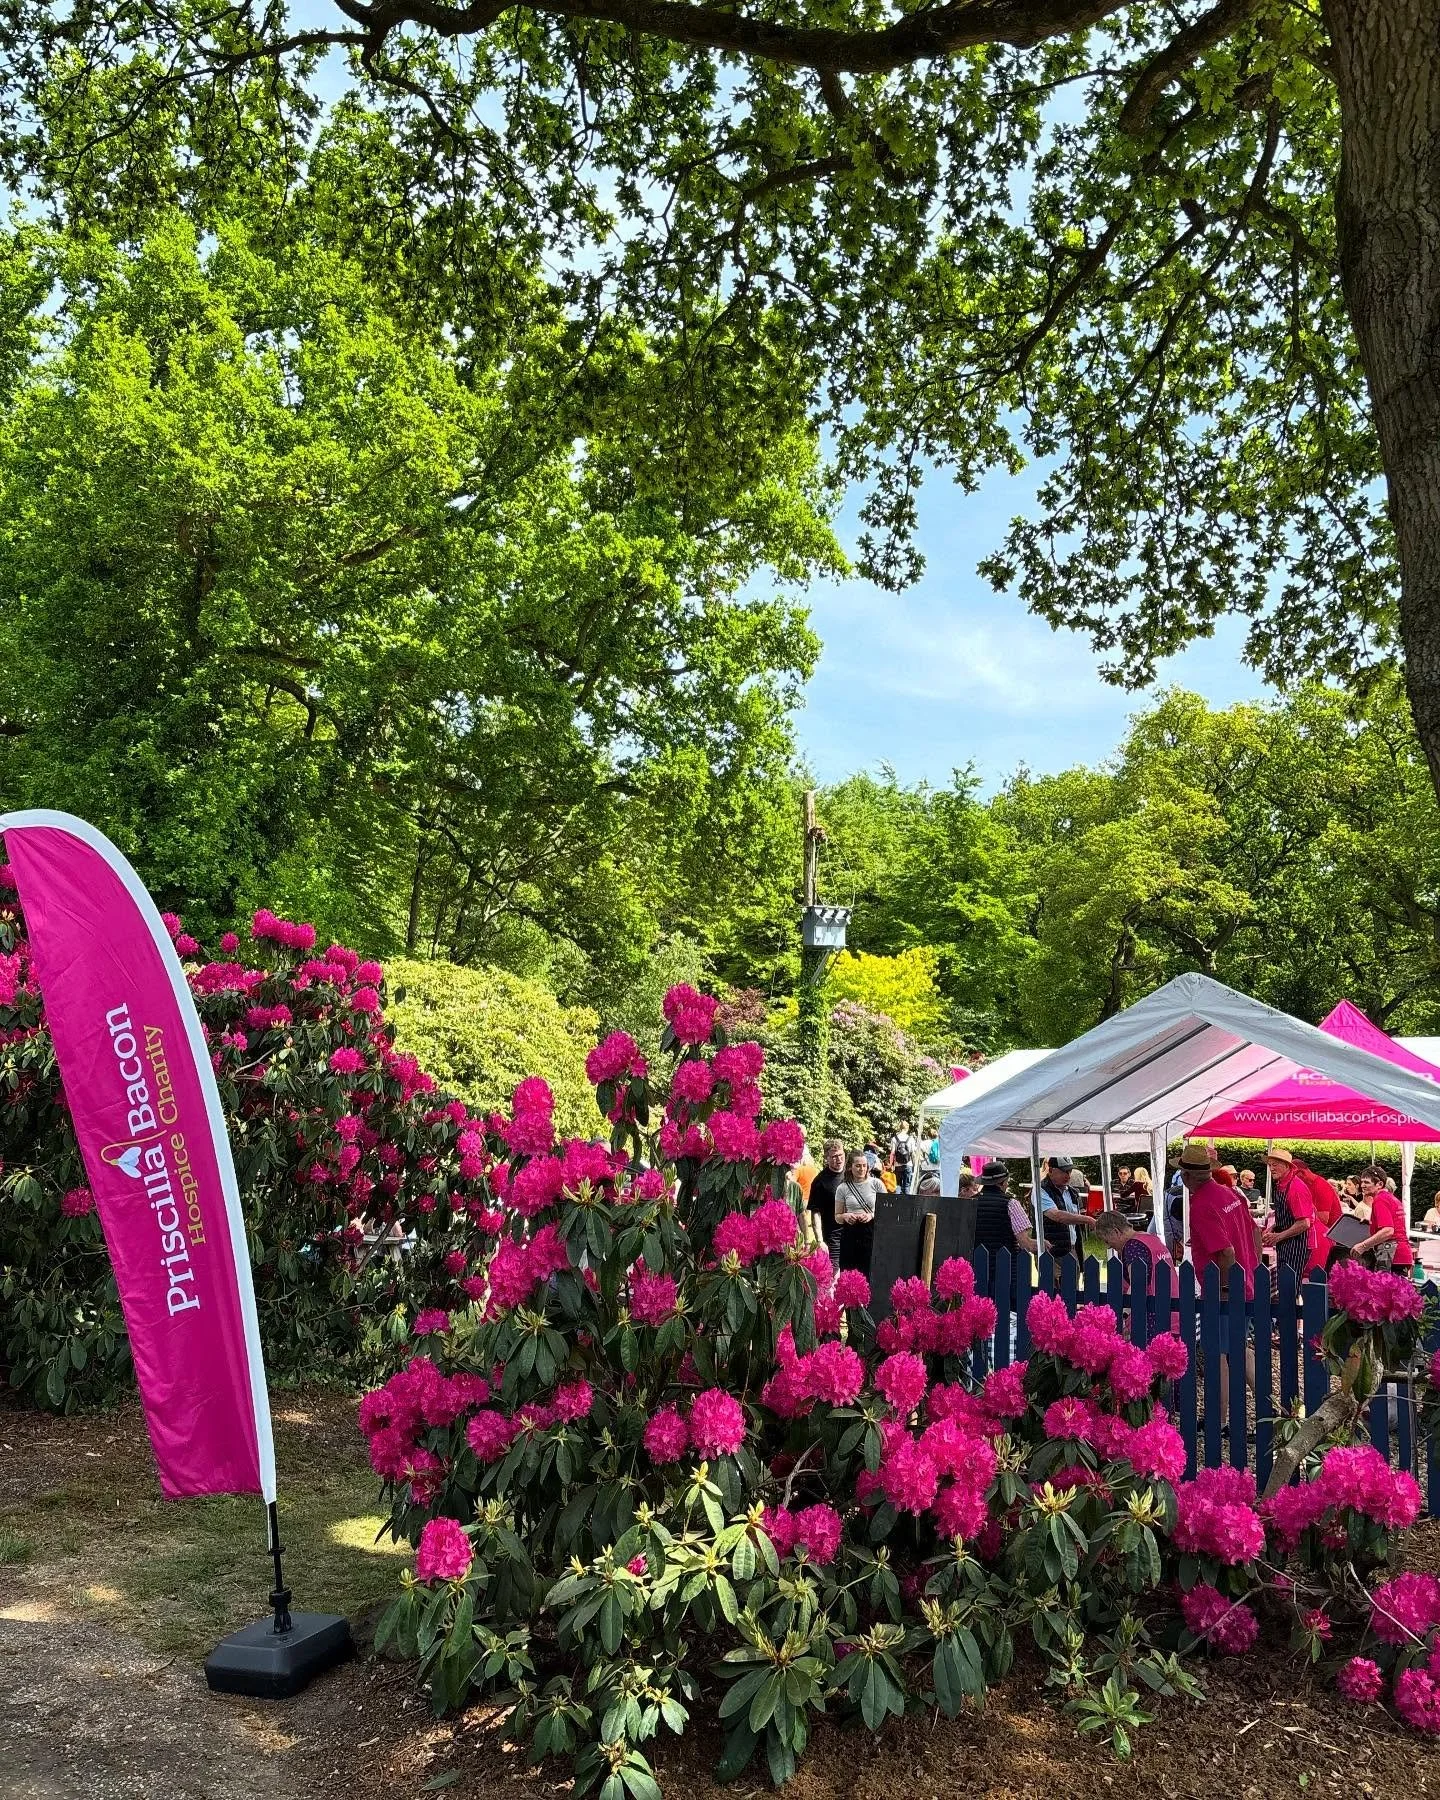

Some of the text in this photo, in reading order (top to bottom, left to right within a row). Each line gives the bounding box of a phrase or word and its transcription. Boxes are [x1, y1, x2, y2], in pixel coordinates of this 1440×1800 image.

[105, 1003, 200, 1316] Priscilla Bacon
[143, 1025, 206, 1246] Hospice Charity
